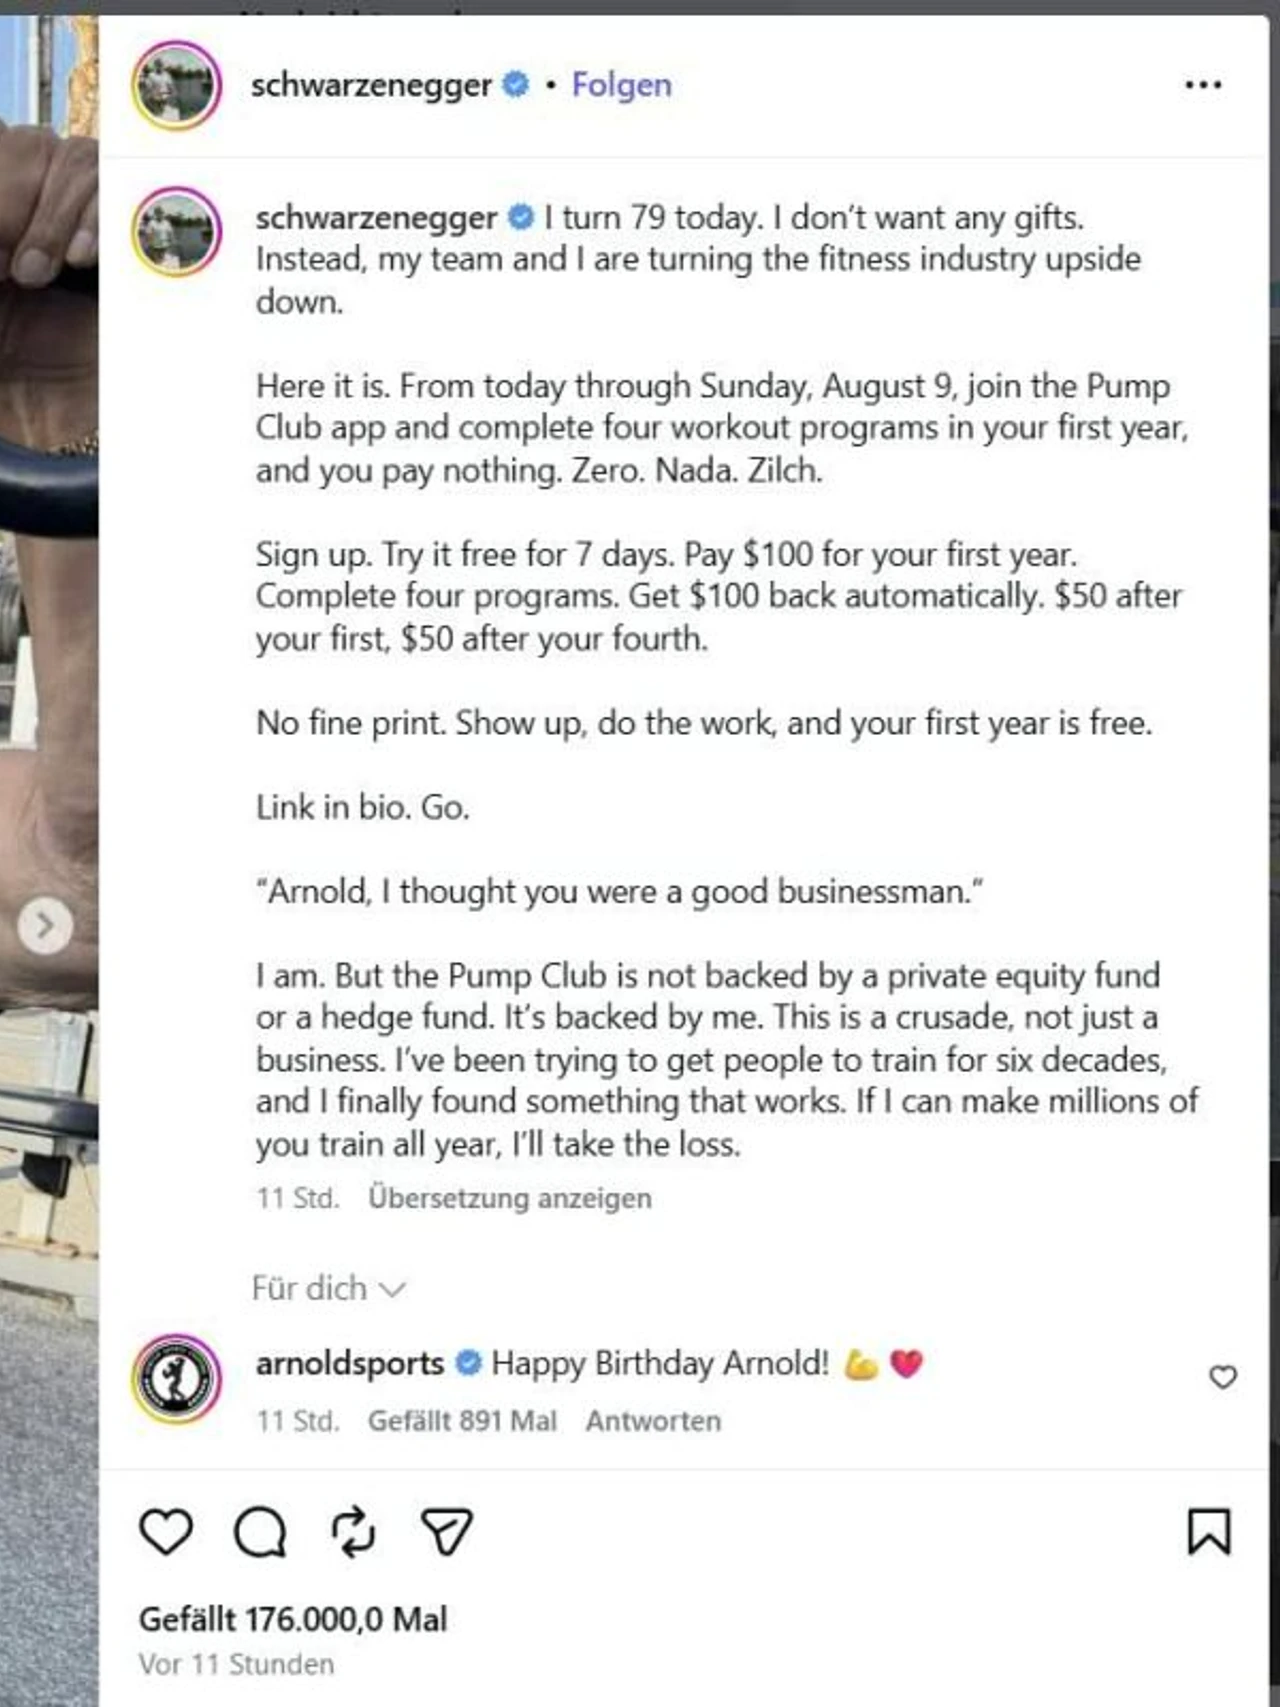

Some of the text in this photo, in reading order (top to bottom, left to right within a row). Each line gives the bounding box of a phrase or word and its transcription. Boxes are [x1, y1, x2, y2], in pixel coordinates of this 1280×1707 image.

[251, 69, 672, 105] schwarzenegger Folgen
[256, 203, 1084, 238] schwarzenegger I turn 79 today. I don’t want any gifts.
[257, 244, 1142, 279] Instead, my team and I are turning the fitness industry upside
[256, 287, 343, 315] down.
[257, 371, 1171, 406] Here it is. From today through Sunday, August 9, join the Pump
[256, 455, 823, 490] and you pay nothing. Zero. Nada. Zilch.
[256, 538, 1076, 575] Sign up. Try it free for 7 days. Pay $100 for your first year.
[256, 622, 708, 658] your first, $50 after your fourth.
[257, 707, 1152, 743] No fine print. Show up, do the work, and your first year is free.
[257, 792, 469, 820] Link in bio. Go.
[383, 878, 389, 904] I
[399, 877, 517, 912] thought
[524, 886, 578, 912] you
[587, 885, 657, 904] were
[666, 885, 682, 904] a
[691, 876, 768, 912] good
[257, 961, 1160, 996] I am. But the Pump Club is not backed by a private equity fund
[257, 1045, 1167, 1080] business. I’ve been trying to get people to train for six decades,
[256, 1086, 1201, 1121] and I finally found something that works. If I can make millions of
[258, 1186, 339, 1209] 11 Std.
[369, 1182, 652, 1215] Übersetzung anzeigen
[253, 1274, 367, 1301] Für dich
[256, 1349, 829, 1383] arnoldsports Happy Birthday Arnold!
[259, 1409, 339, 1432] 11 Std.
[368, 1409, 557, 1432] Gefällt 891 Mal
[586, 1409, 721, 1432] Antworten
[139, 1605, 447, 1636] Gefällt 176.000,0 Mal
[138, 1653, 334, 1675] Vor 11 Stunden
